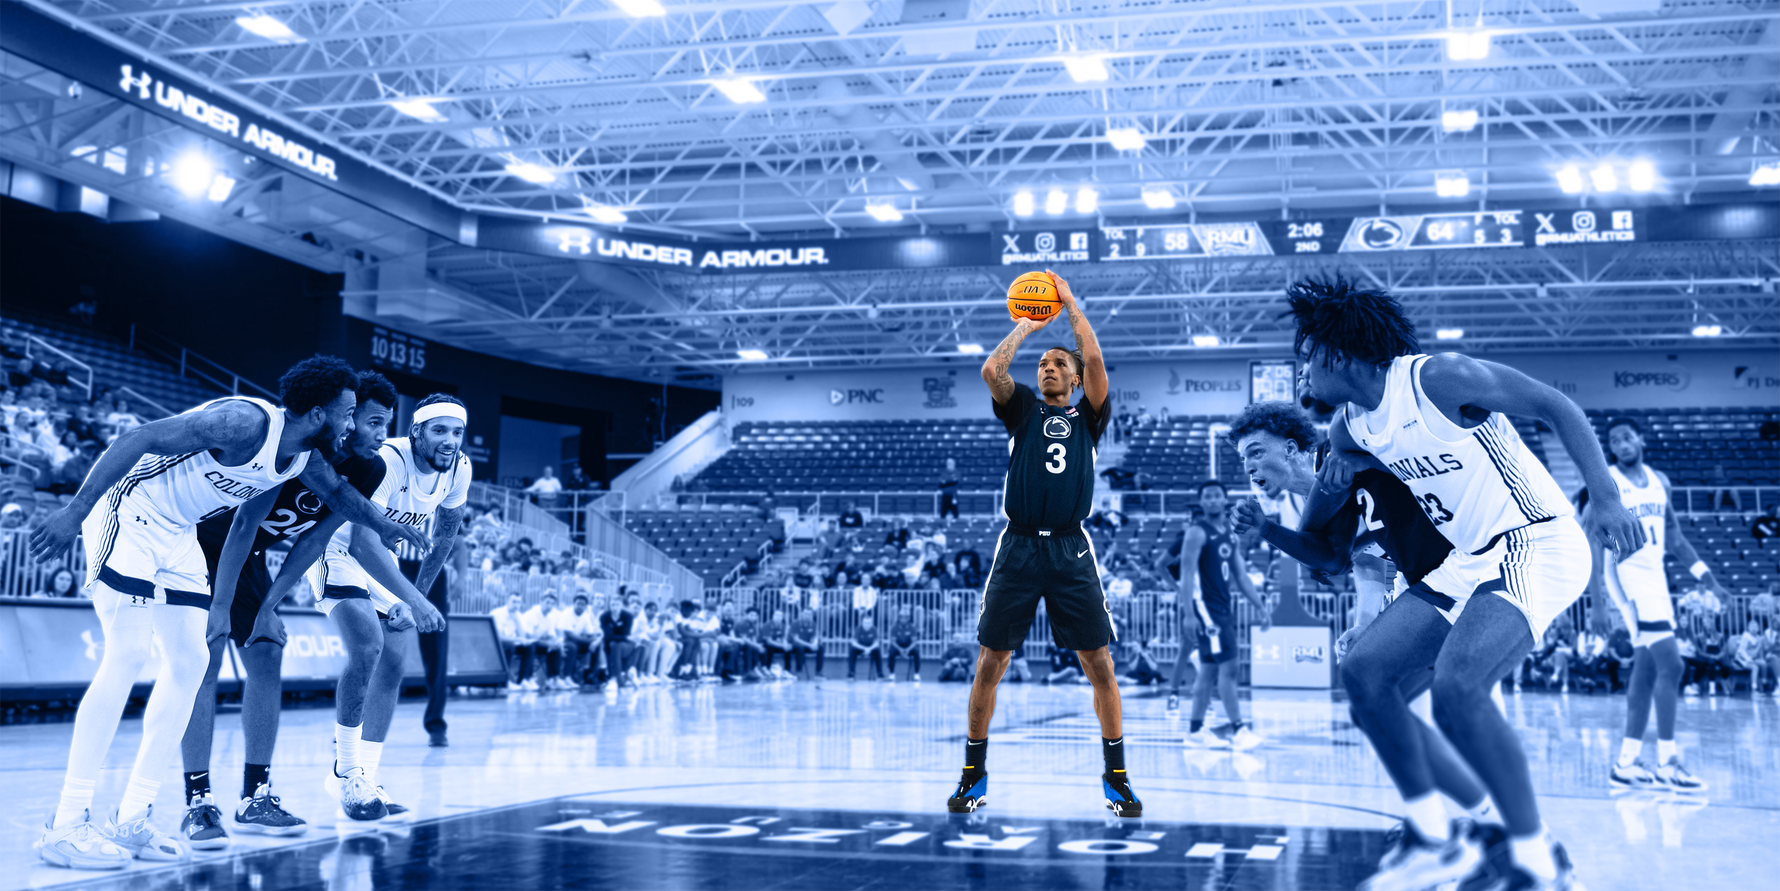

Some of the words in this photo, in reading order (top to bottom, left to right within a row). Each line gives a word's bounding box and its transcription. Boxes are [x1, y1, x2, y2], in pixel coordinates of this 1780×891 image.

[155, 80, 240, 138] UNDER
[1288, 222, 1323, 238] 2:06
[1427, 222, 1454, 241] 64
[1500, 228, 1512, 244] 3
[1109, 242, 1120, 257] 2
[1135, 242, 1146, 257] 9
[1164, 232, 1189, 251] 58
[1295, 241, 1321, 252] 2ND
[597, 238, 693, 266] UNDER
[1015, 303, 1052, 315] Wilson
[371, 335, 388, 359] 10
[390, 341, 407, 365] 13
[408, 347, 426, 369] 15
[1185, 379, 1242, 393] PEOPLES
[1614, 371, 1680, 388] KOPPERS
[736, 396, 755, 407] 109
[848, 388, 884, 404] PNC
[1045, 442, 1067, 474] 3
[534, 818, 1284, 860] HORIZON
